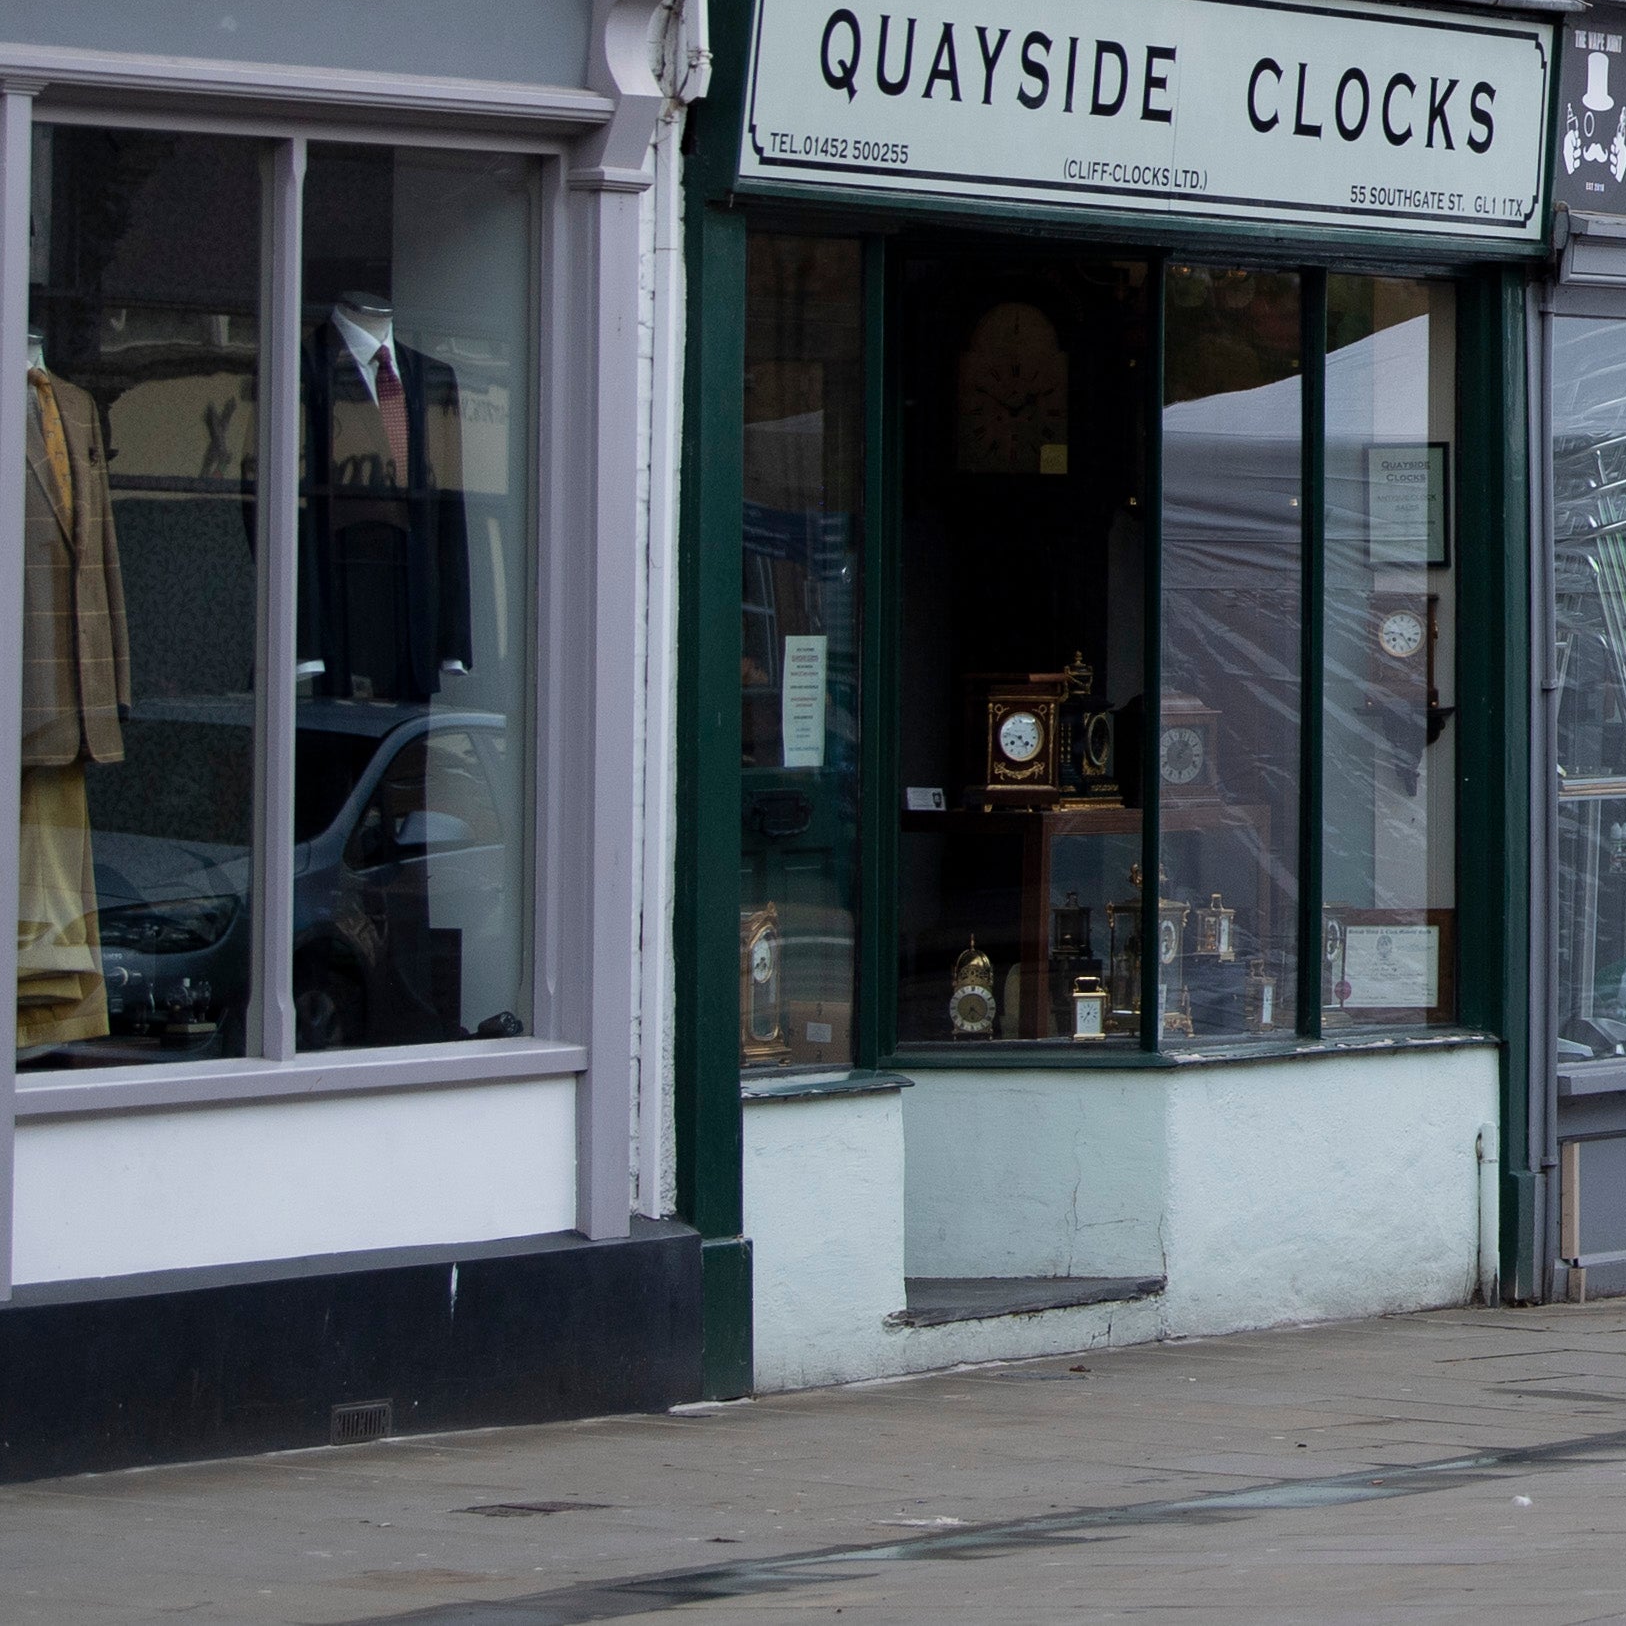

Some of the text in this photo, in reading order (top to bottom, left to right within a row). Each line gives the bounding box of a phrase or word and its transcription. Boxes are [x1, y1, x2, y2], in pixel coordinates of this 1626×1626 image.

[820, 8, 1498, 154] QUAYSIDE CLOCKS
[852, 140, 909, 164] 500255
[1174, 169, 1208, 191] LTD.)
[1350, 185, 1523, 217] 55 SOUTHGATE ST. GL1 1TX
